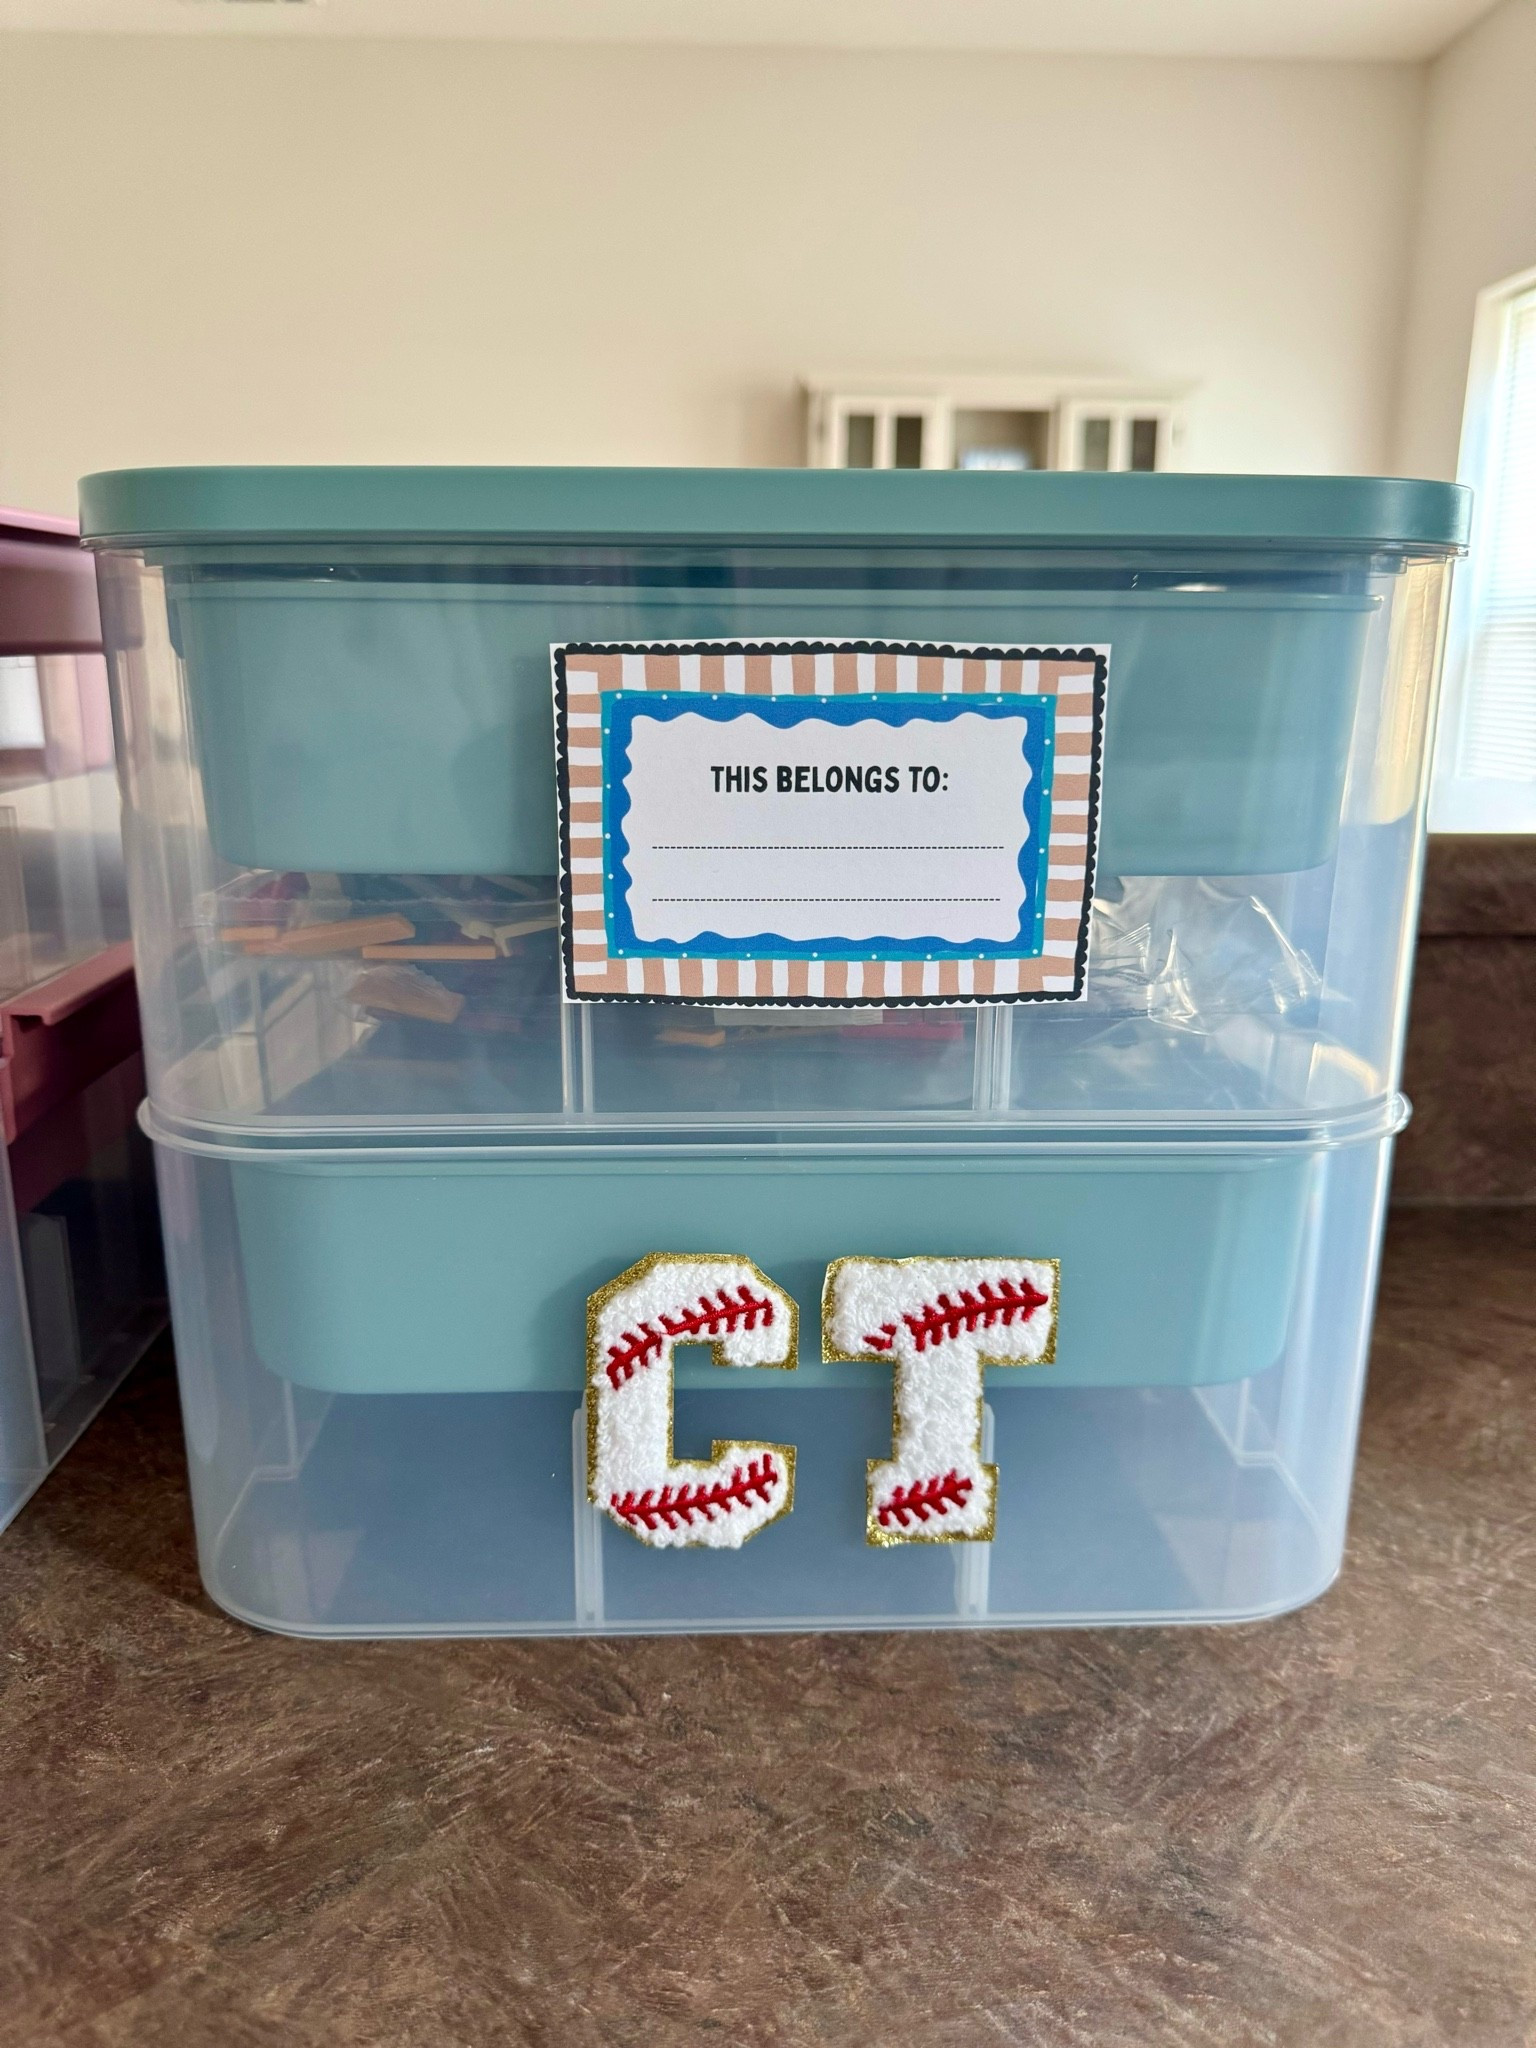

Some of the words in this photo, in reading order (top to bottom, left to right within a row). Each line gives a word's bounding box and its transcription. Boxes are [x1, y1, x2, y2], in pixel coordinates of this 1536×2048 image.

[710, 765, 768, 793] THIS
[776, 765, 900, 793] BELONGS
[908, 765, 949, 793] TO:
